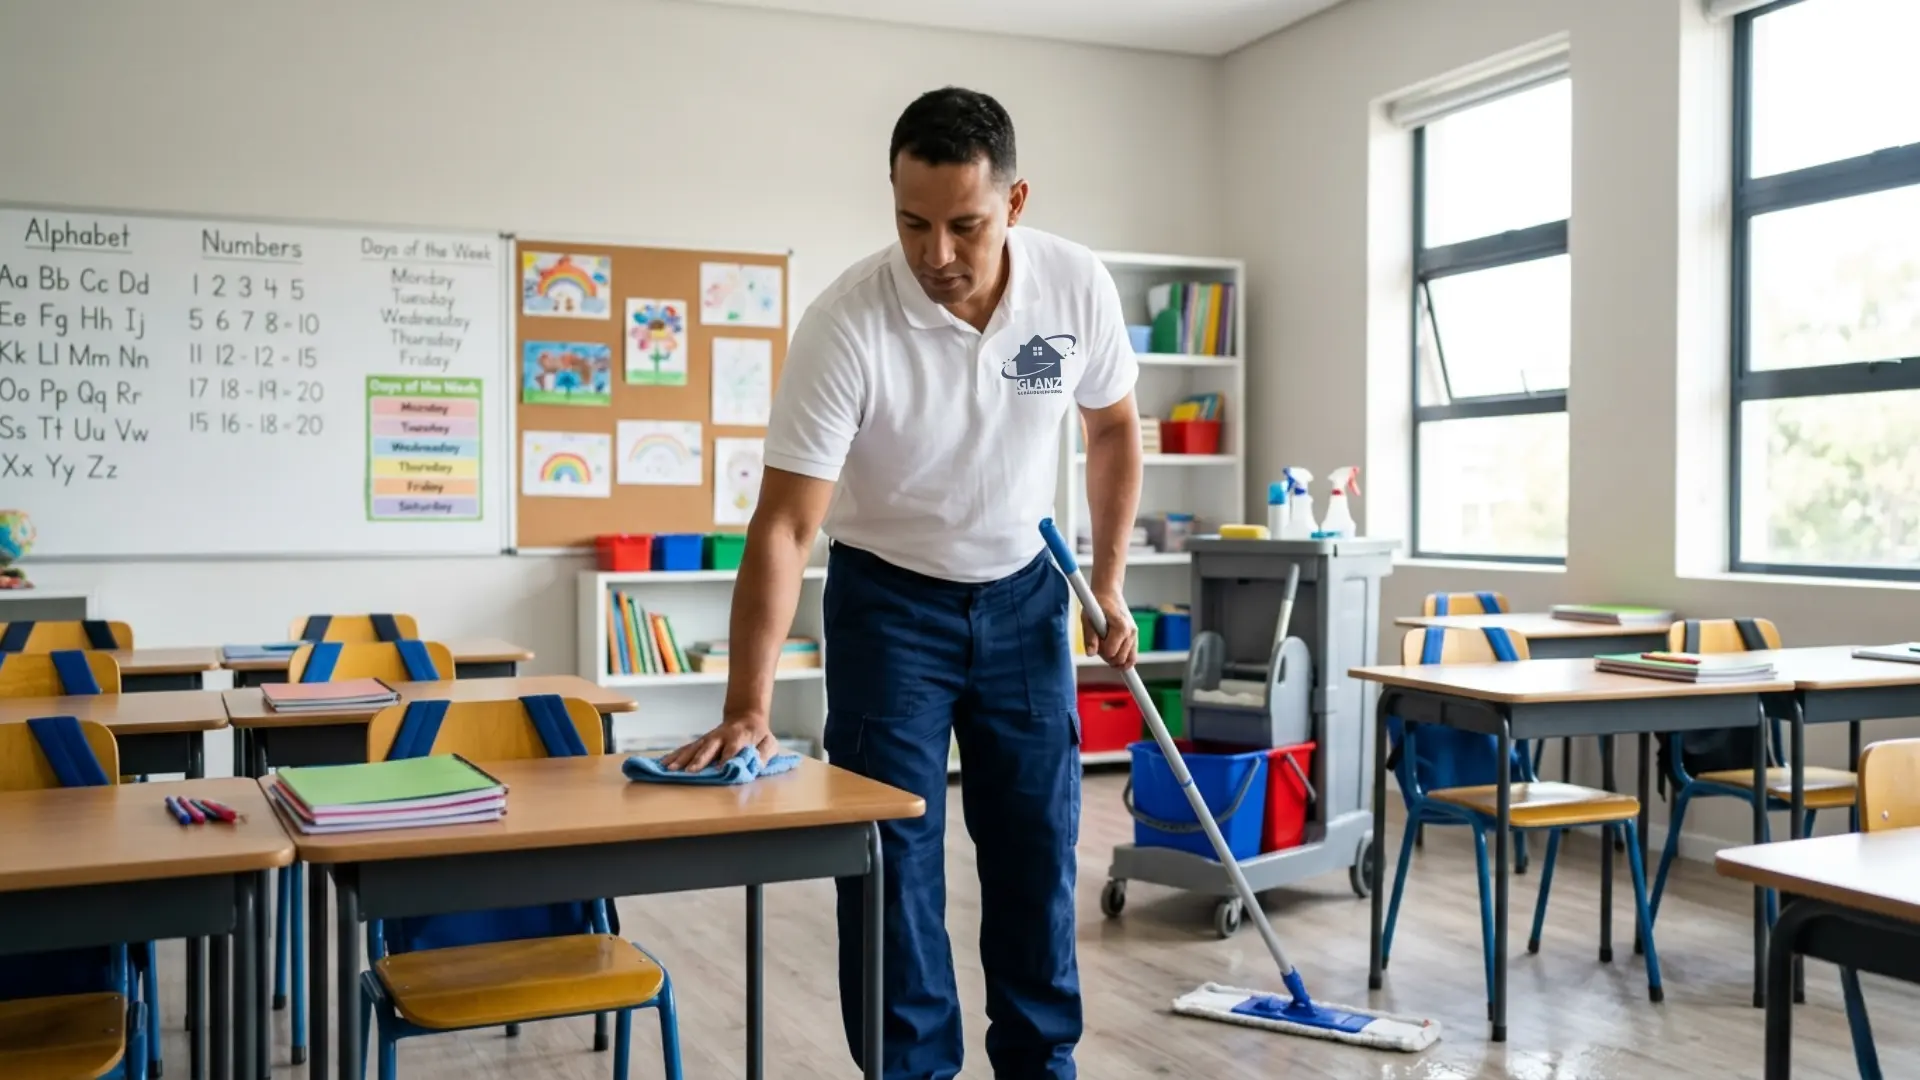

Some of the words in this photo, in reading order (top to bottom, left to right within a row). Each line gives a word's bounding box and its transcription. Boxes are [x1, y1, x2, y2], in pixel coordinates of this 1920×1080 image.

[25, 217, 131, 252] Alphabet
[202, 228, 303, 258] Numbers
[361, 236, 399, 260] Days
[403, 239, 420, 256] of
[425, 241, 448, 258] the
[453, 243, 492, 260] Week
[0, 264, 28, 289] Aa
[39, 265, 70, 291] Bb
[80, 267, 109, 294] Cc
[119, 269, 149, 295] Dd
[212, 274, 226, 298] 2
[238, 275, 252, 298] 3
[264, 277, 278, 299] 4
[291, 278, 305, 301] 5
[391, 268, 455, 291] Monday
[392, 287, 455, 312] Tuesday
[0, 301, 26, 327] Ee
[40, 303, 68, 337] Fg
[81, 305, 113, 331] Hh
[125, 307, 145, 340] Ij
[189, 308, 203, 331] 5
[216, 309, 230, 332] 6
[241, 310, 255, 332] 7
[265, 311, 279, 334] 8
[299, 313, 320, 335] 10
[380, 308, 471, 334] Wednesday
[391, 328, 462, 353] Thursday
[38, 341, 59, 366] Ll
[69, 342, 110, 367] Mm
[119, 344, 149, 369] Nn
[216, 344, 235, 366] 12
[255, 345, 274, 367] 12
[298, 347, 317, 368] 15
[400, 350, 450, 373] Friday
[0, 376, 30, 402] Oo
[41, 378, 68, 411] Pp
[77, 380, 107, 414] Qq
[117, 381, 142, 405] Rr
[190, 377, 209, 398] 17
[221, 378, 240, 400] 18
[259, 379, 277, 401] 19
[297, 380, 324, 403] 20
[370, 380, 402, 395] Days
[404, 380, 418, 393] of
[445, 381, 479, 394] Week
[1017, 377, 1062, 390] GLANZ
[0, 414, 27, 440] Ss
[38, 416, 63, 441] Tt
[74, 417, 105, 441] Uu
[115, 418, 149, 442] Vw
[190, 412, 209, 433] 15
[222, 412, 240, 434] 16
[260, 413, 278, 435] 18
[297, 414, 323, 436] 20
[2, 453, 34, 478] Xx
[45, 454, 75, 487] Yy
[87, 454, 118, 479] Zz
